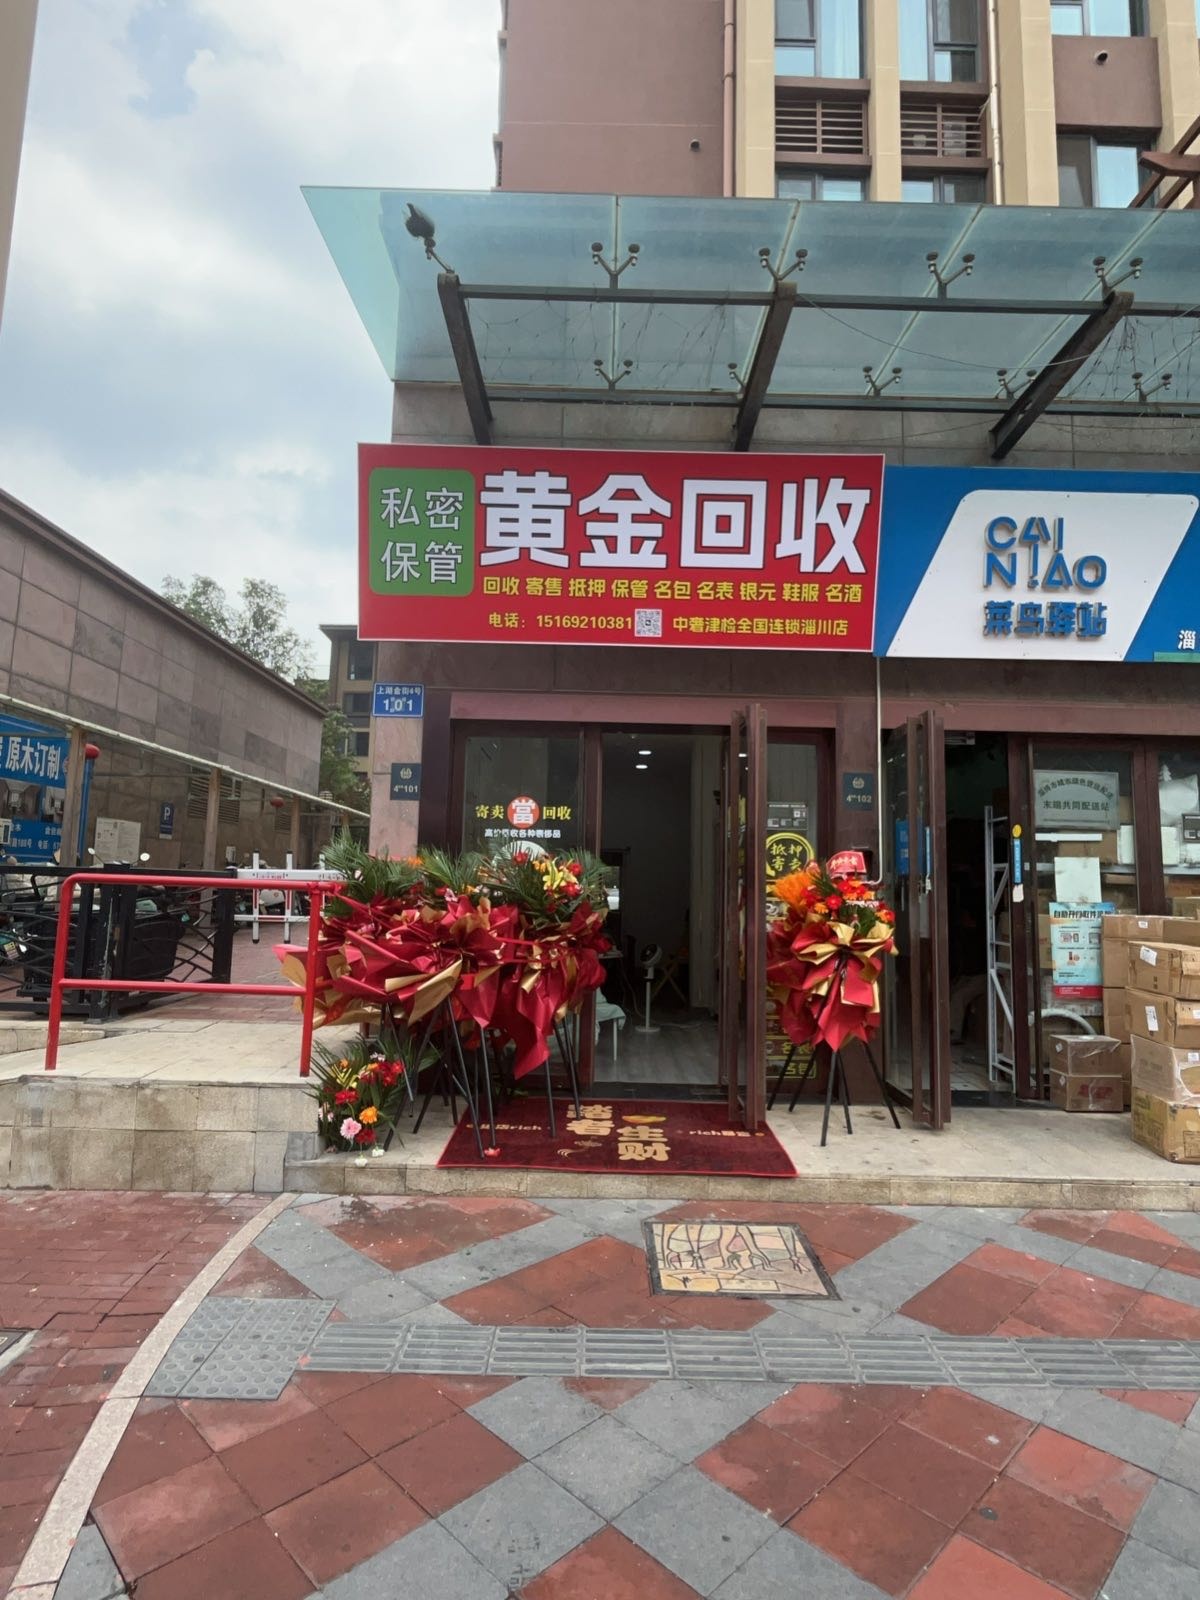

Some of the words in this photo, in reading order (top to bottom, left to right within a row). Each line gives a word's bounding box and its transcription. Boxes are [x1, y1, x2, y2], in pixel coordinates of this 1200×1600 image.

[381, 487, 464, 531] 私密
[479, 470, 870, 574] 黄金回收
[984, 516, 1065, 551] CAI
[381, 540, 464, 584] 保管
[483, 576, 520, 596] 回收
[525, 576, 562, 597] 寄售
[568, 578, 606, 598] 抵押
[611, 579, 649, 599] 保管
[653, 580, 691, 600] 名包
[697, 581, 734, 601] 名表
[739, 582, 776, 602] 银元
[782, 583, 819, 602] 鞋服
[825, 584, 862, 603] 名酒
[536, 614, 632, 630] 15169210381
[983, 601, 1107, 638] 菜鸟驿站
[1177, 629, 1196, 650] 淄
[383, 698, 413, 712] 101
[0, 736, 61, 780] 原木订制
[164, 807, 171, 820] P
[474, 804, 505, 819] 寄卖
[542, 805, 572, 820] 回收
[769, 843, 804, 857] 抵押
